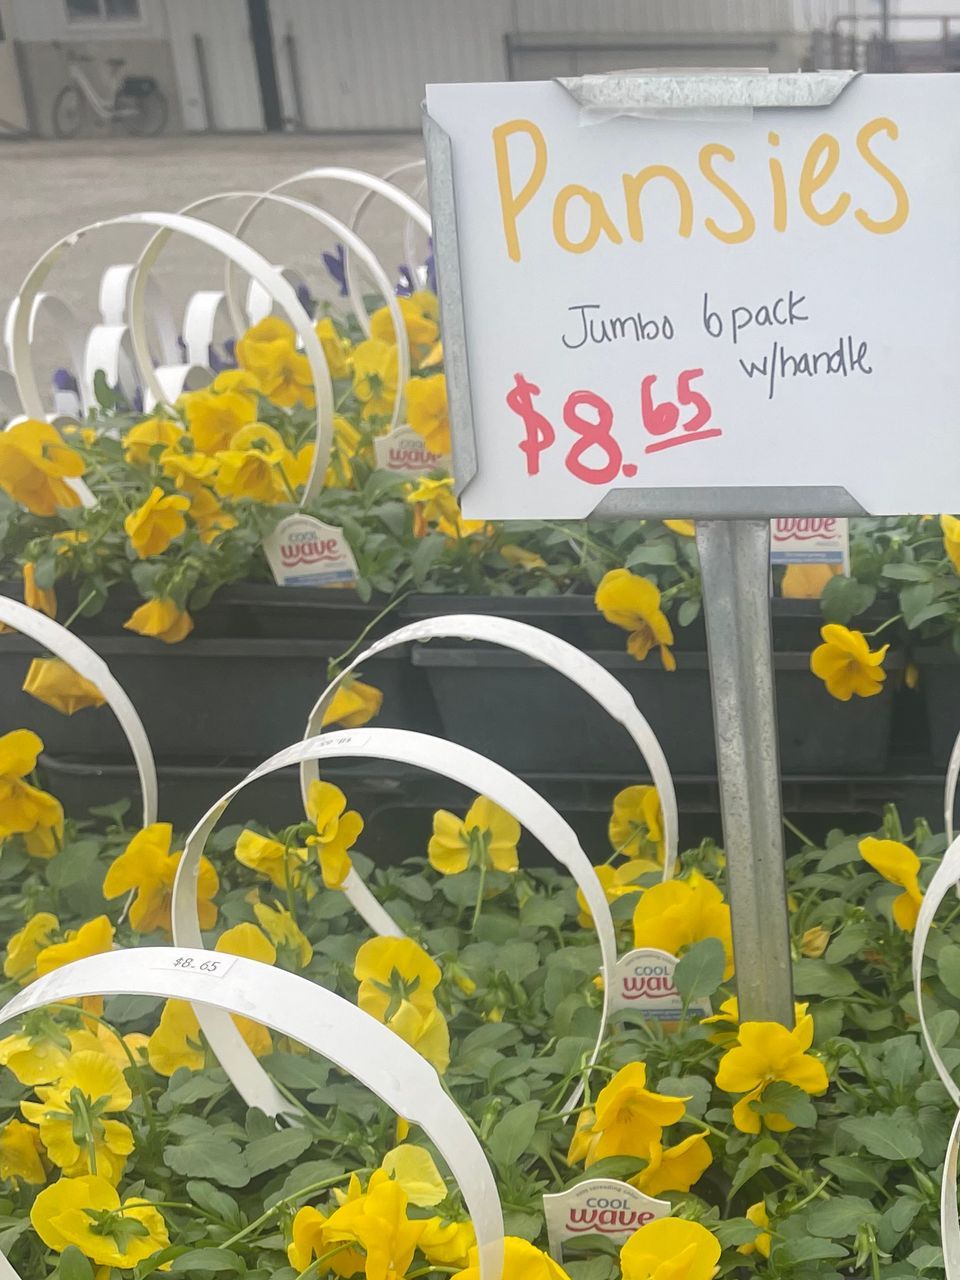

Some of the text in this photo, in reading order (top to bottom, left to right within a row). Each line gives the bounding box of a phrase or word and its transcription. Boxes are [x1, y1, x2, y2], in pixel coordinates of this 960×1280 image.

[492, 117, 910, 263] Pansies
[561, 303, 676, 349] Jumbo
[739, 336, 873, 400] w/handle
[506, 367, 718, 485] $8.65
[280, 539, 338, 559] wave
[634, 965, 671, 976] COOL
[623, 976, 676, 991] wav
[586, 1197, 632, 1210] COOL
[570, 1208, 656, 1227] wave
